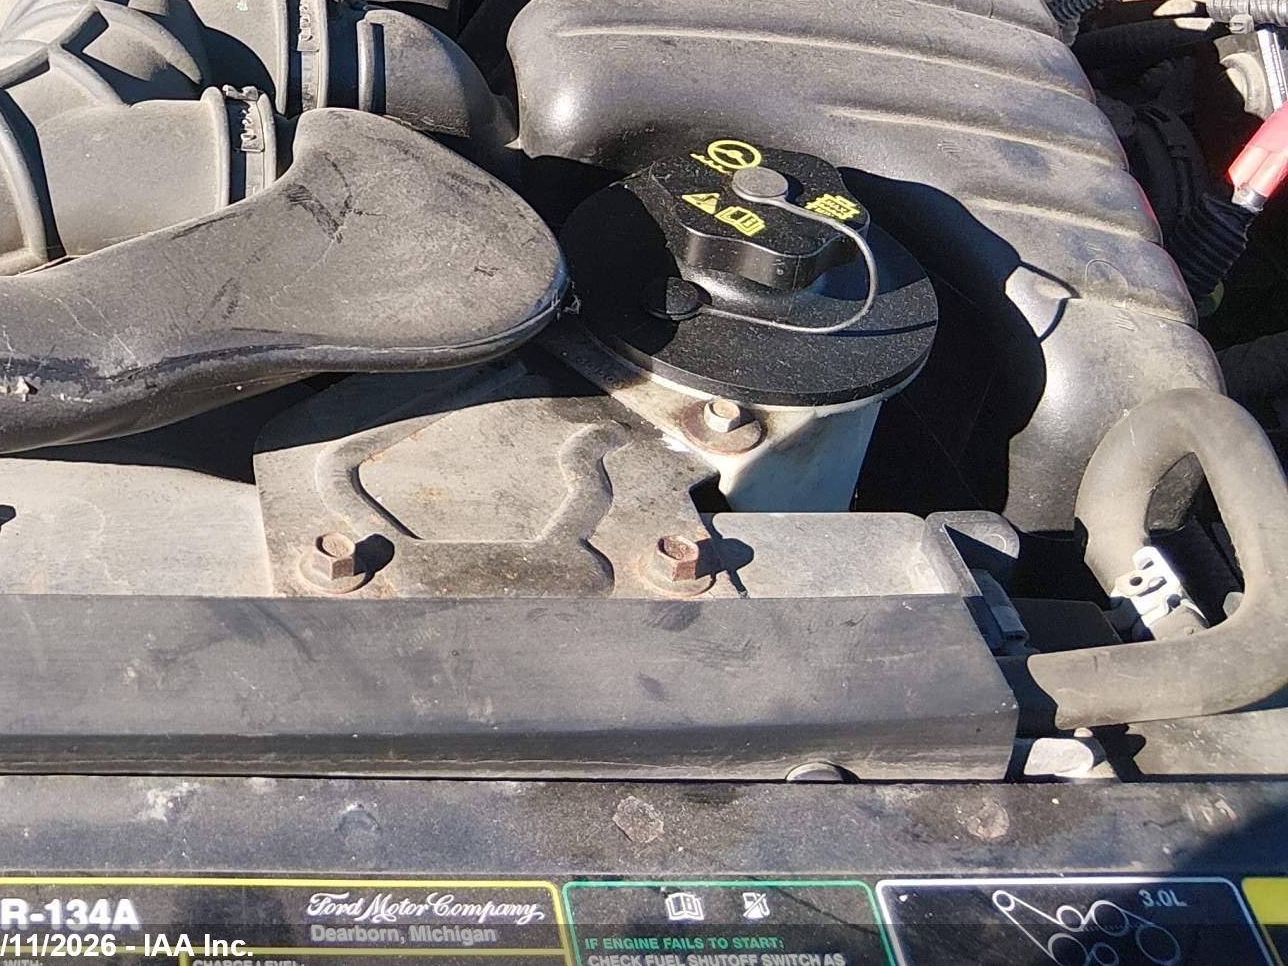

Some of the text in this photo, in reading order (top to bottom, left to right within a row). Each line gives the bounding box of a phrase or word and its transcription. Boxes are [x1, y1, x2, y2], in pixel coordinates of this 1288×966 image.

[307, 892, 545, 925] Ford Motor Company
[1139, 889, 1187, 908] 3.0L
[0, 898, 141, 930] R-134A
[311, 924, 497, 945] Dearborn, Michigan
[585, 938, 599, 949] IF
[603, 938, 659, 949] ENGINE
[663, 938, 705, 949] FAILS
[710, 938, 729, 949] TO
[588, 954, 846, 966] CHECK FUEL SHUTOFF SWITCH AS
